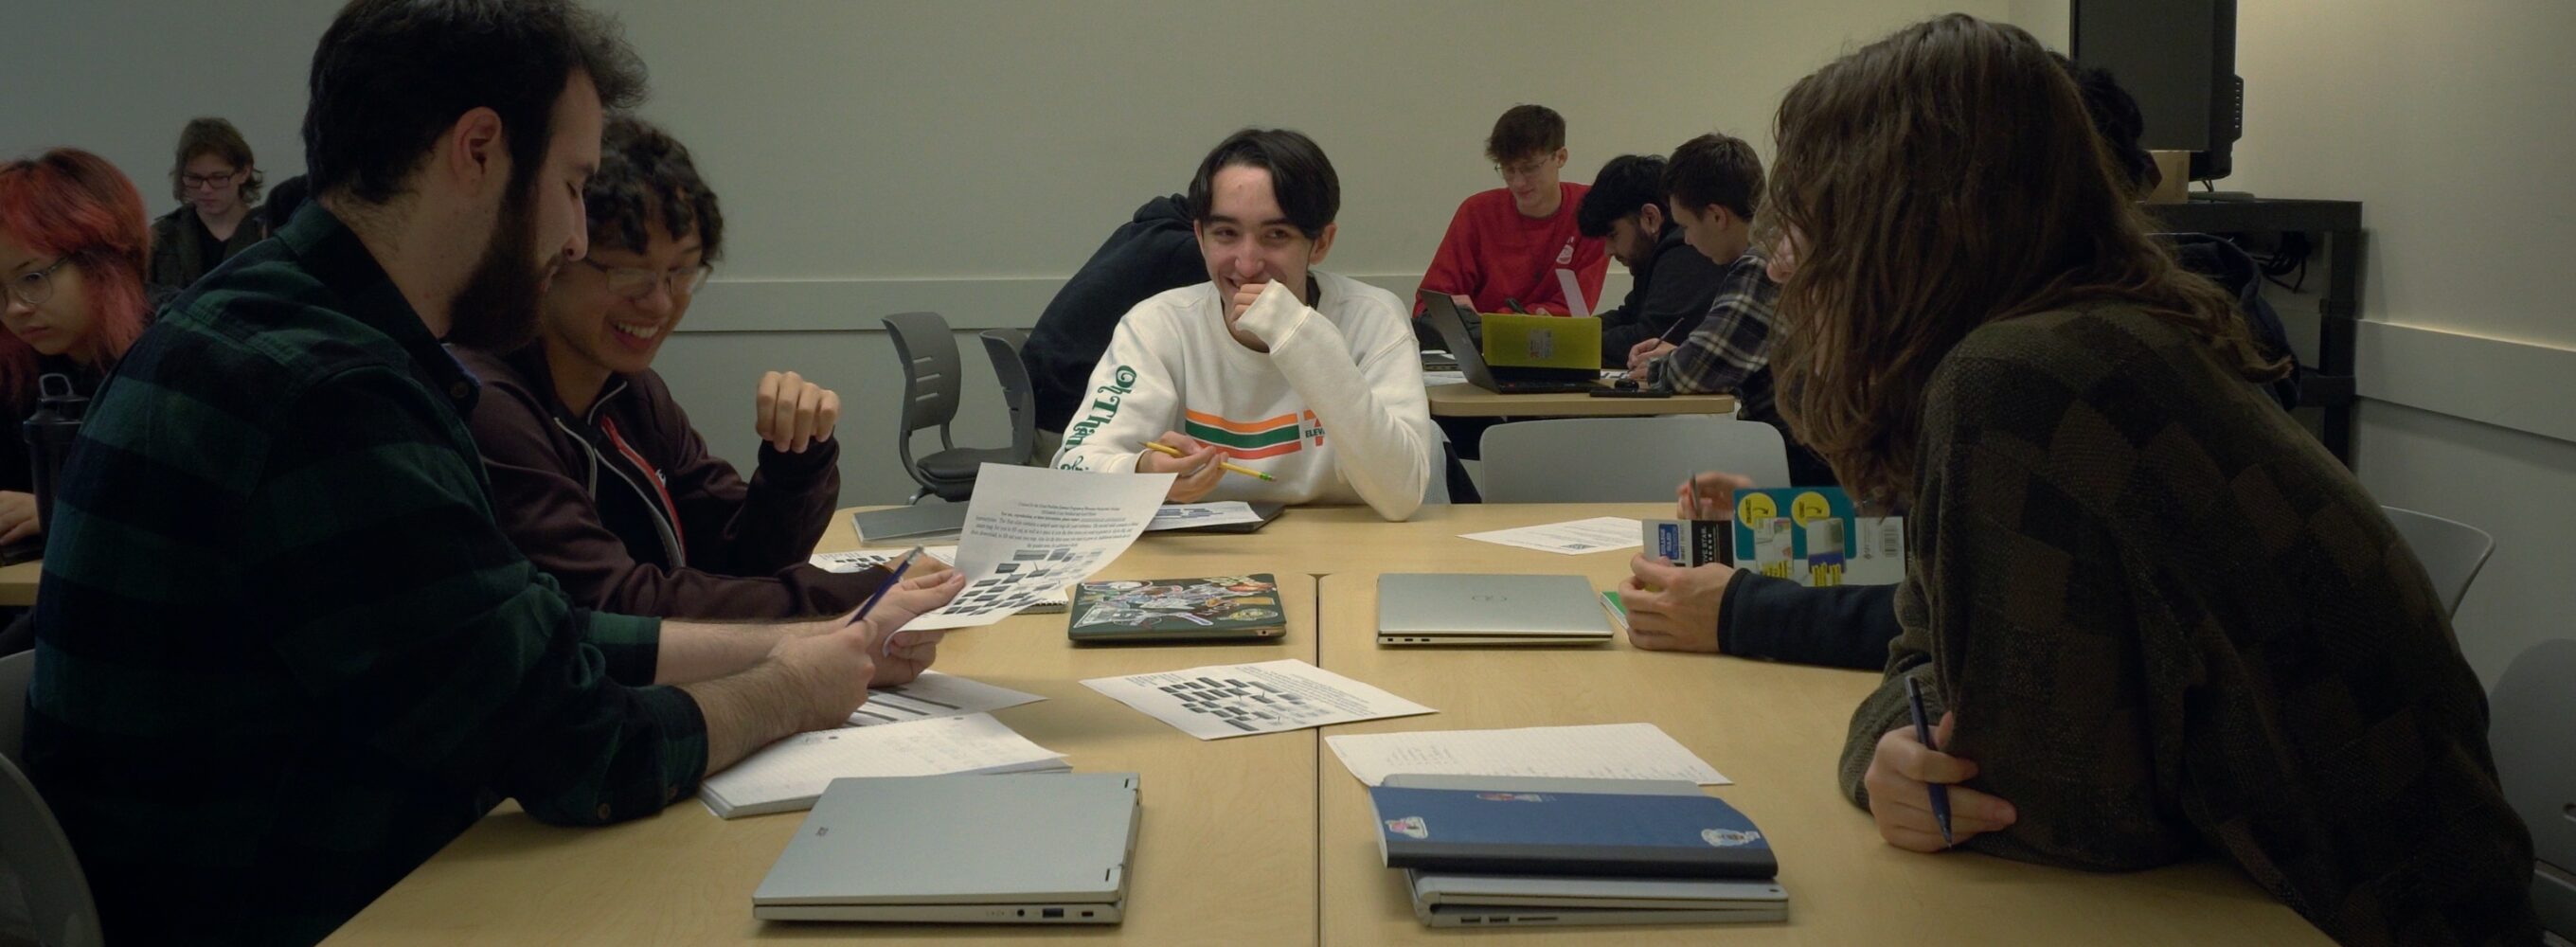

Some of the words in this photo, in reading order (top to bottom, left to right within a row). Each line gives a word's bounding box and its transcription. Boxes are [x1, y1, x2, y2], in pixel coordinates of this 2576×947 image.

[1097, 365, 1137, 395] Oh
[1064, 395, 1121, 453] Than
[1305, 428, 1325, 438] ELEV
